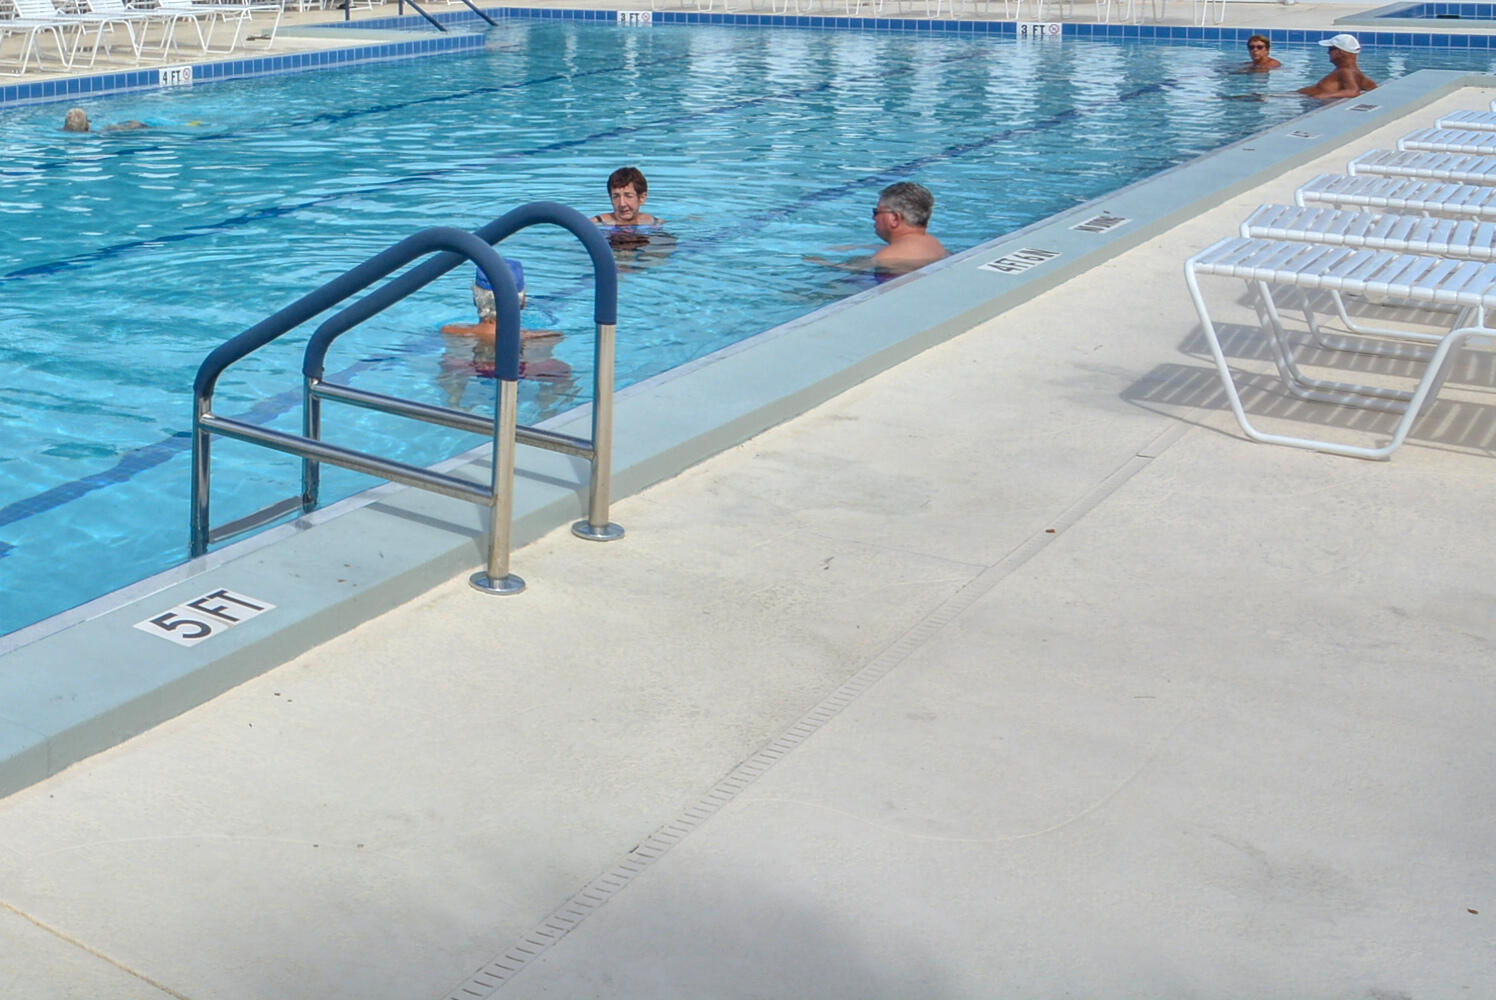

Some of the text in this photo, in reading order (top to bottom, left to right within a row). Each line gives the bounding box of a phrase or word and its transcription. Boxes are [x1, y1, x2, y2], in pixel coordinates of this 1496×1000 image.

[1021, 24, 1028, 34] 3
[163, 71, 168, 85] 4
[149, 589, 265, 639] 5 FT
